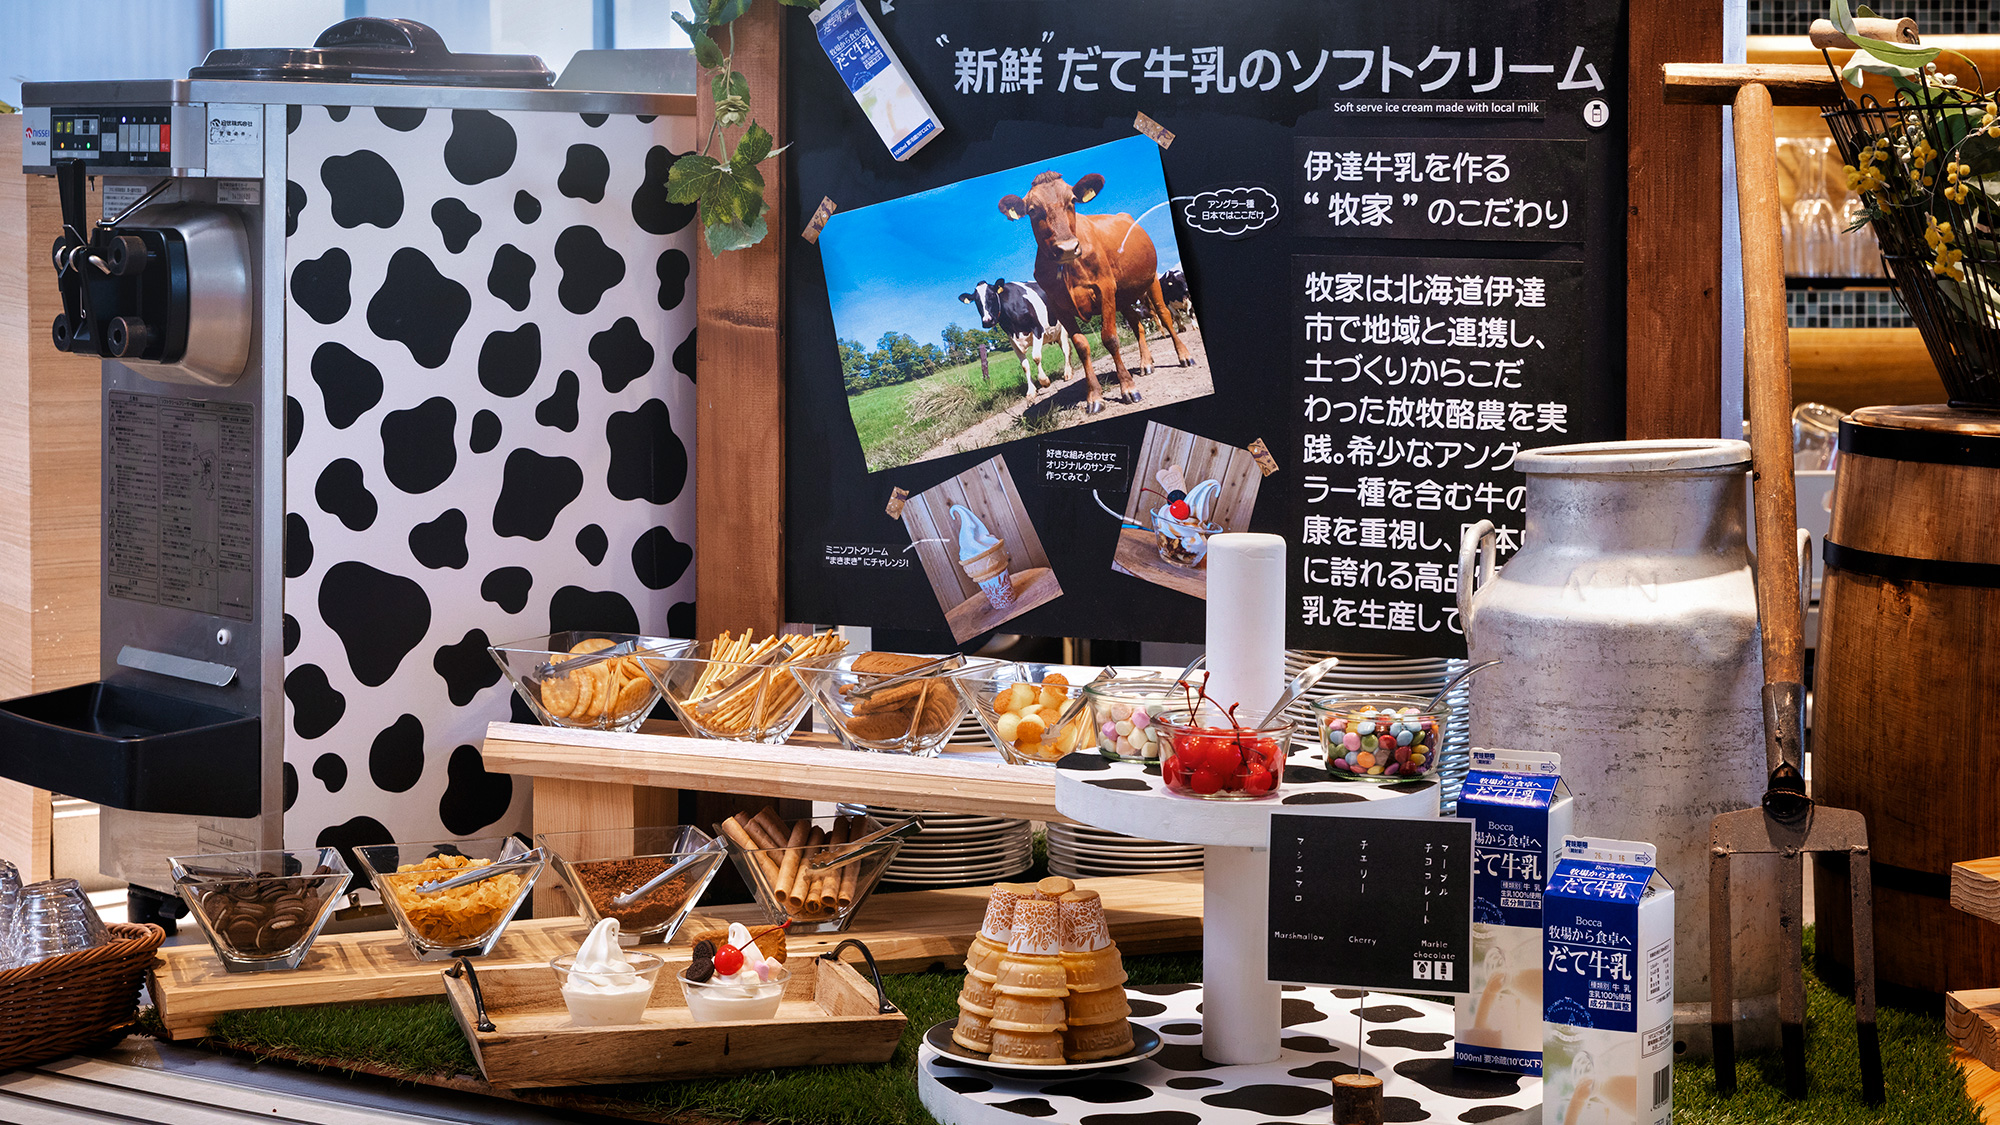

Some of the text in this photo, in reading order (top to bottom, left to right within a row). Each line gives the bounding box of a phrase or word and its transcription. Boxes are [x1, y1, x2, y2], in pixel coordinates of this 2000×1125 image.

[836, 34, 876, 71] だて牛乳
[1334, 102, 1539, 113] Soft serve ice cream made with local milk
[1303, 150, 1511, 184] 伊達牛乳を作る
[1207, 199, 1255, 209] アングラー種
[1202, 210, 1265, 221] 日本ではここだけ
[1304, 271, 1547, 308] 牧家は北海道伊達
[1304, 312, 1545, 350] 市で地域と連携し、
[1303, 353, 1525, 389] 土づくりからこだ
[1303, 394, 1568, 434] わった放牧酪農を実
[1046, 448, 1117, 462] 好きな組み合わせで
[1302, 433, 1521, 473] 践。希少なアング
[1046, 460, 1122, 473] オリジナルのサンデー
[1302, 475, 1527, 514] ラー種を含む牛の
[825, 545, 889, 556] ミニソフトクリーム
[1479, 777, 1542, 788] 牧場から食卓へ
[1474, 786, 1537, 804] だて牛乳
[1488, 820, 1514, 832] Bocca
[1294, 837, 1305, 902] マシュマロ
[1359, 840, 1369, 893] チェリー
[1438, 844, 1449, 896] マーブル
[1569, 868, 1634, 881] 牧場から食卓へ
[1423, 843, 1433, 925] チョコレート
[1560, 877, 1627, 899] だて牛乳
[1575, 915, 1603, 928] Bocca
[1274, 931, 1325, 941] Marshmallow
[1348, 936, 1377, 946] Cherry
[1548, 924, 1632, 946] 牧場から食卓へ
[1421, 940, 1448, 949] Marble
[1413, 950, 1456, 960] chocolate
[1548, 945, 1632, 981] だて牛乳
[1588, 990, 1632, 1001] 生乳100%使用
[1456, 1051, 1482, 1063] 1000ml
